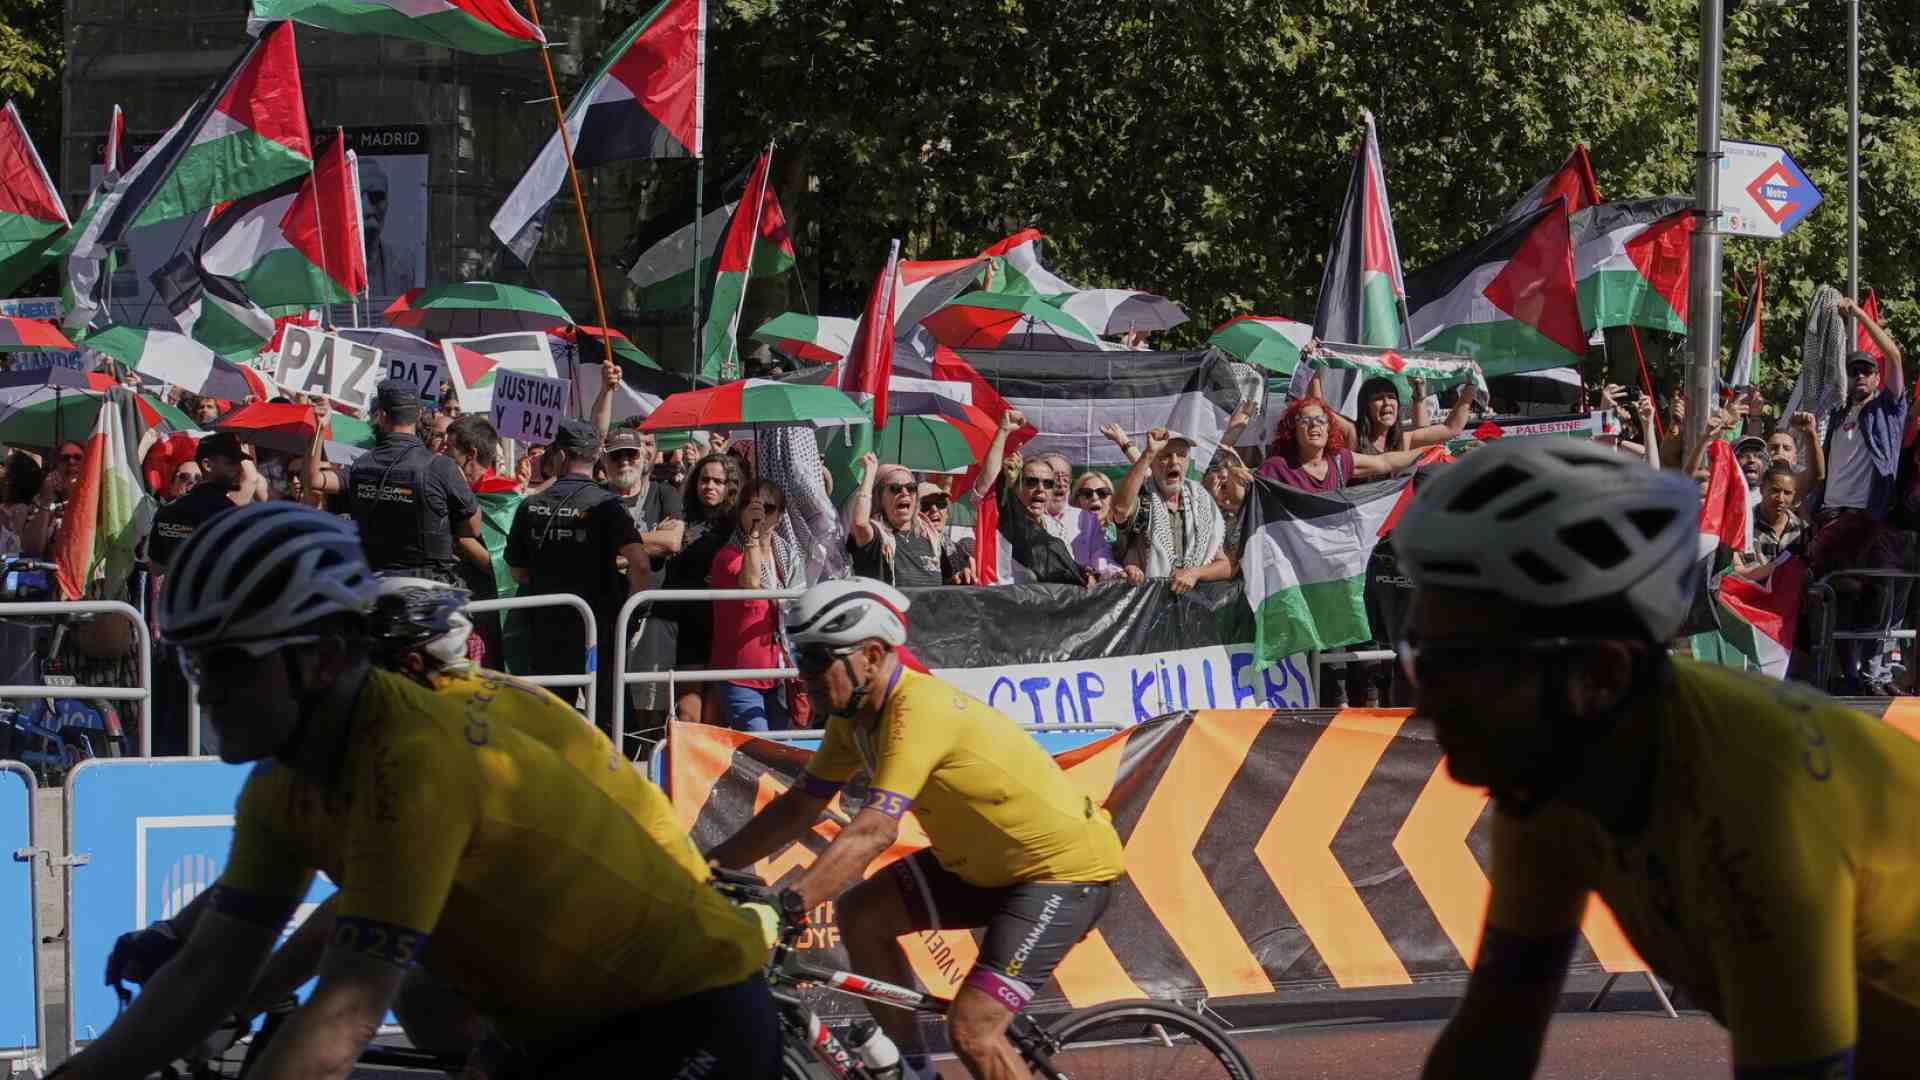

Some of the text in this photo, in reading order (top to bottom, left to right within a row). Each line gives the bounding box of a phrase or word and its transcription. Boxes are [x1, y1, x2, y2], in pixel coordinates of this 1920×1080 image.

[361, 131, 420, 146] MADRID
[276, 327, 377, 406] PAZ
[390, 359, 439, 401] PAZ
[497, 375, 562, 411] JUSTICIA
[495, 405, 554, 439] Y PAZ
[1516, 419, 1585, 434] PALESTINE
